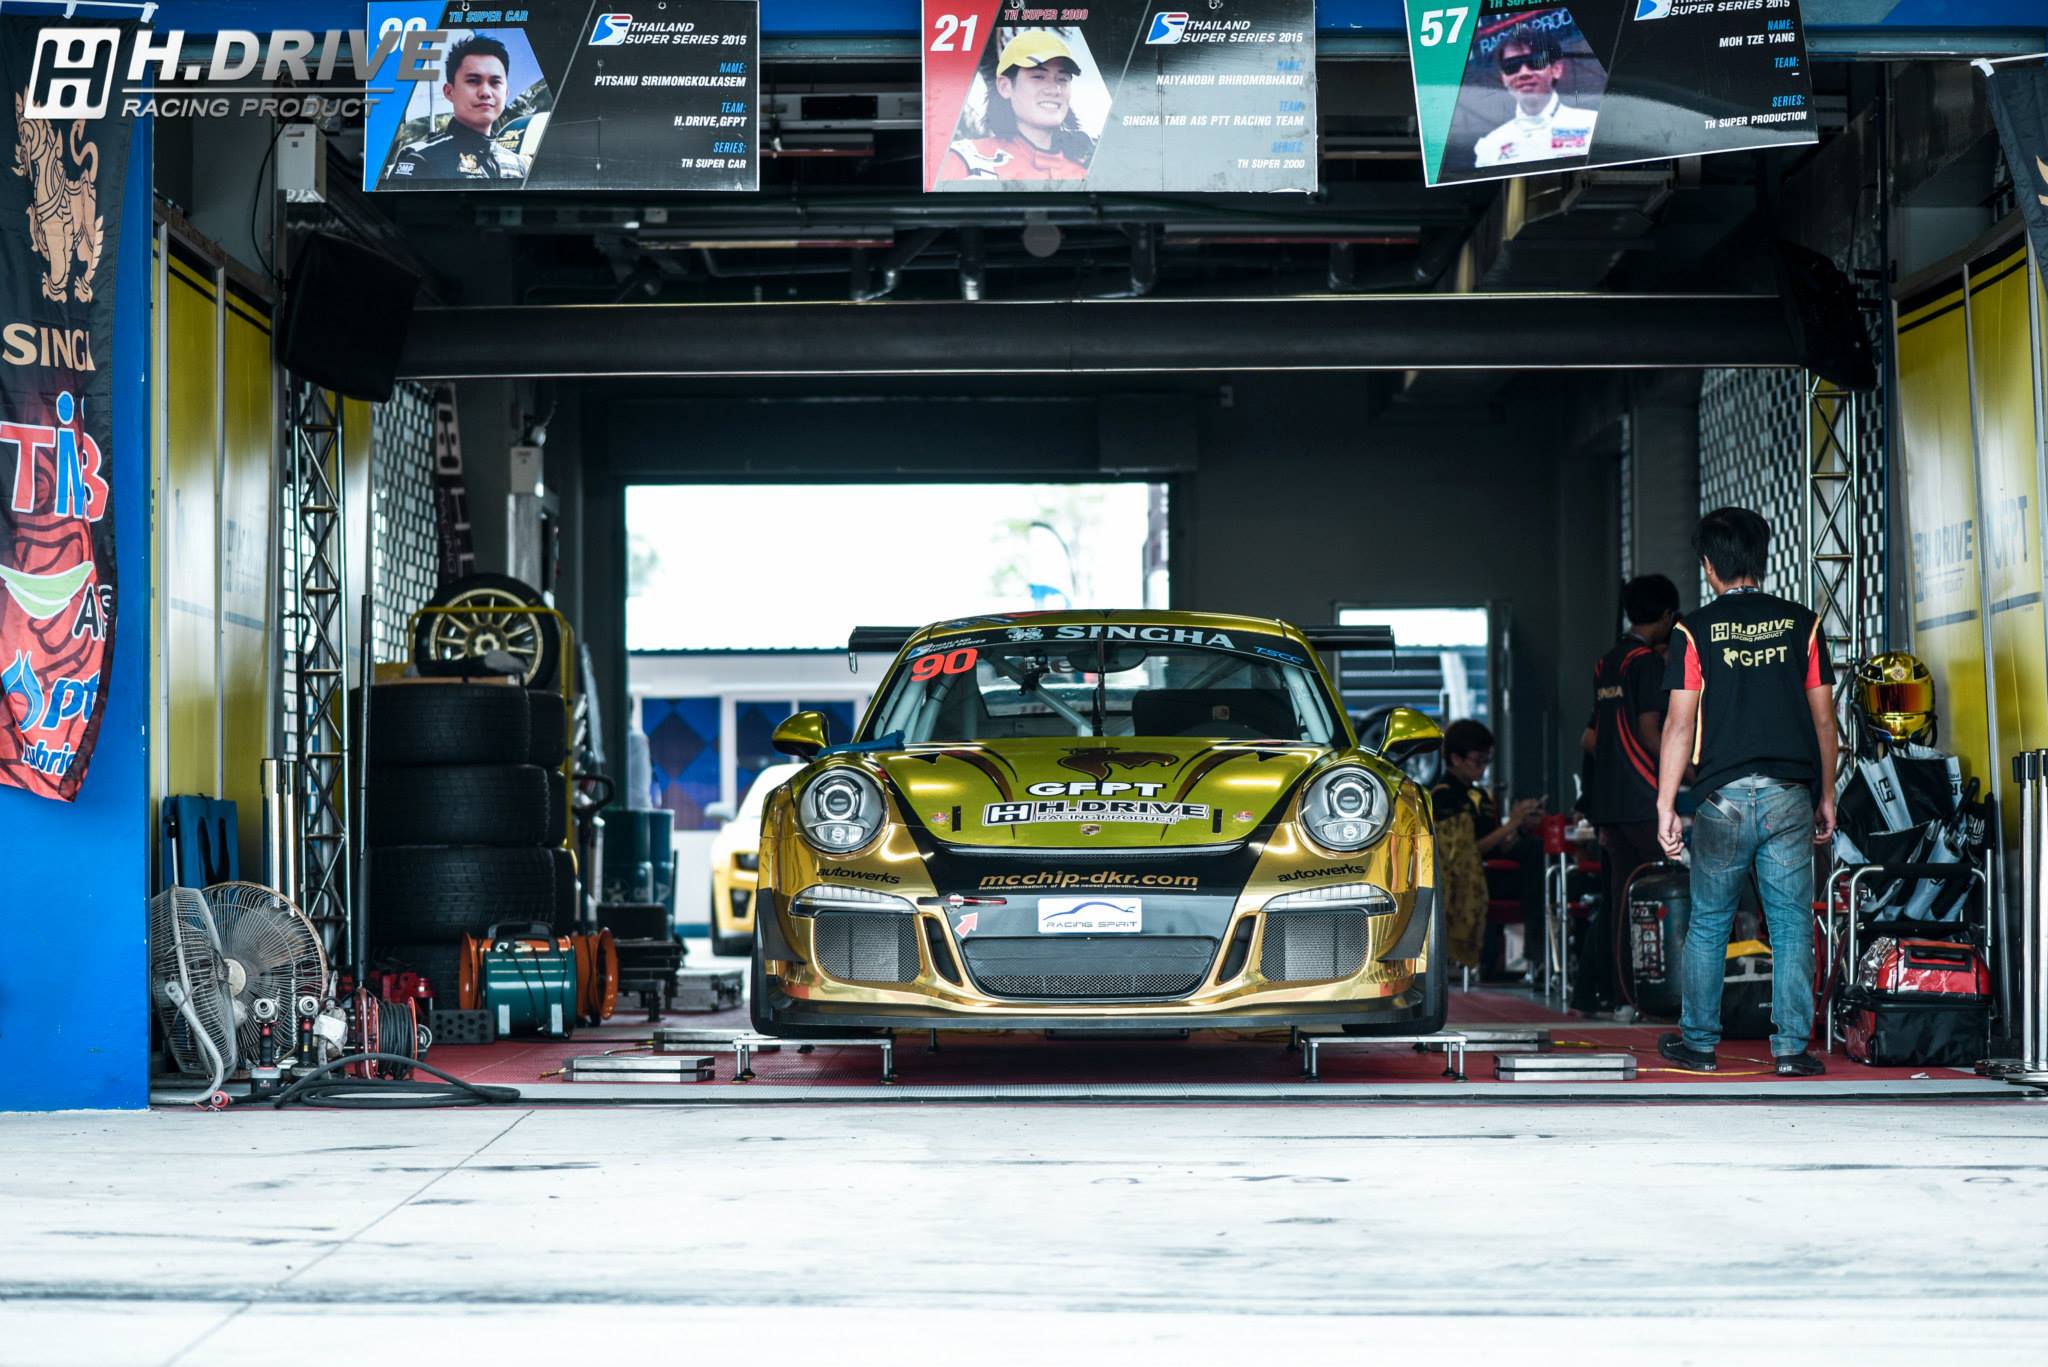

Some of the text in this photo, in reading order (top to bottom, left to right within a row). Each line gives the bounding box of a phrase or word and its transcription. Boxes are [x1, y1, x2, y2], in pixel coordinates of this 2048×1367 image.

[1004, 9, 1088, 20] TH SUPER 2000
[1671, 0, 1790, 16] SUPER SERIES 2015
[449, 10, 528, 23] TH SUPER CAR
[631, 22, 694, 32] THAILAND
[1187, 20, 1251, 30] THAILAND
[1420, 7, 1469, 47] 57
[1767, 19, 1795, 31] NAME:
[625, 34, 747, 45] SUPER SERIES 2015
[930, 14, 978, 52] 21
[1182, 32, 1303, 43] SUPER SERIES 2015
[1719, 32, 1795, 48] MOH TZE YANG
[719, 62, 747, 74] NAME:
[1774, 56, 1800, 69] TEAM:
[595, 75, 746, 87] PITSANU SIRIMONGKOLKASEM
[721, 102, 747, 113] TEAM:
[1772, 95, 1806, 108] SERIES:
[674, 116, 747, 128] H.DRIVE,GFPT
[1122, 115, 1304, 127] SINGHA TMB AIS PTT RACING TEAM
[1704, 111, 1807, 130] TH SUPER PRODUCTION
[713, 142, 747, 153] SERIES:
[682, 158, 746, 169] TH SUPER CAR
[1237, 159, 1305, 169] TH SUPER 2000
[1731, 619, 1794, 635] H.DRIVE
[1054, 625, 1235, 649] SINGHA
[1731, 631, 1784, 642] RACING PRODUCT
[1740, 646, 1788, 667] GFPT
[911, 648, 979, 682] 90
[1027, 781, 1168, 797] GFPT
[1038, 801, 1206, 817] H.DRIVE
[1037, 813, 1179, 823] RACING PRODUCT
[816, 866, 901, 884] autowerks
[980, 871, 1199, 888] mcchip-dkr.com
[1277, 864, 1366, 882] autowerks
